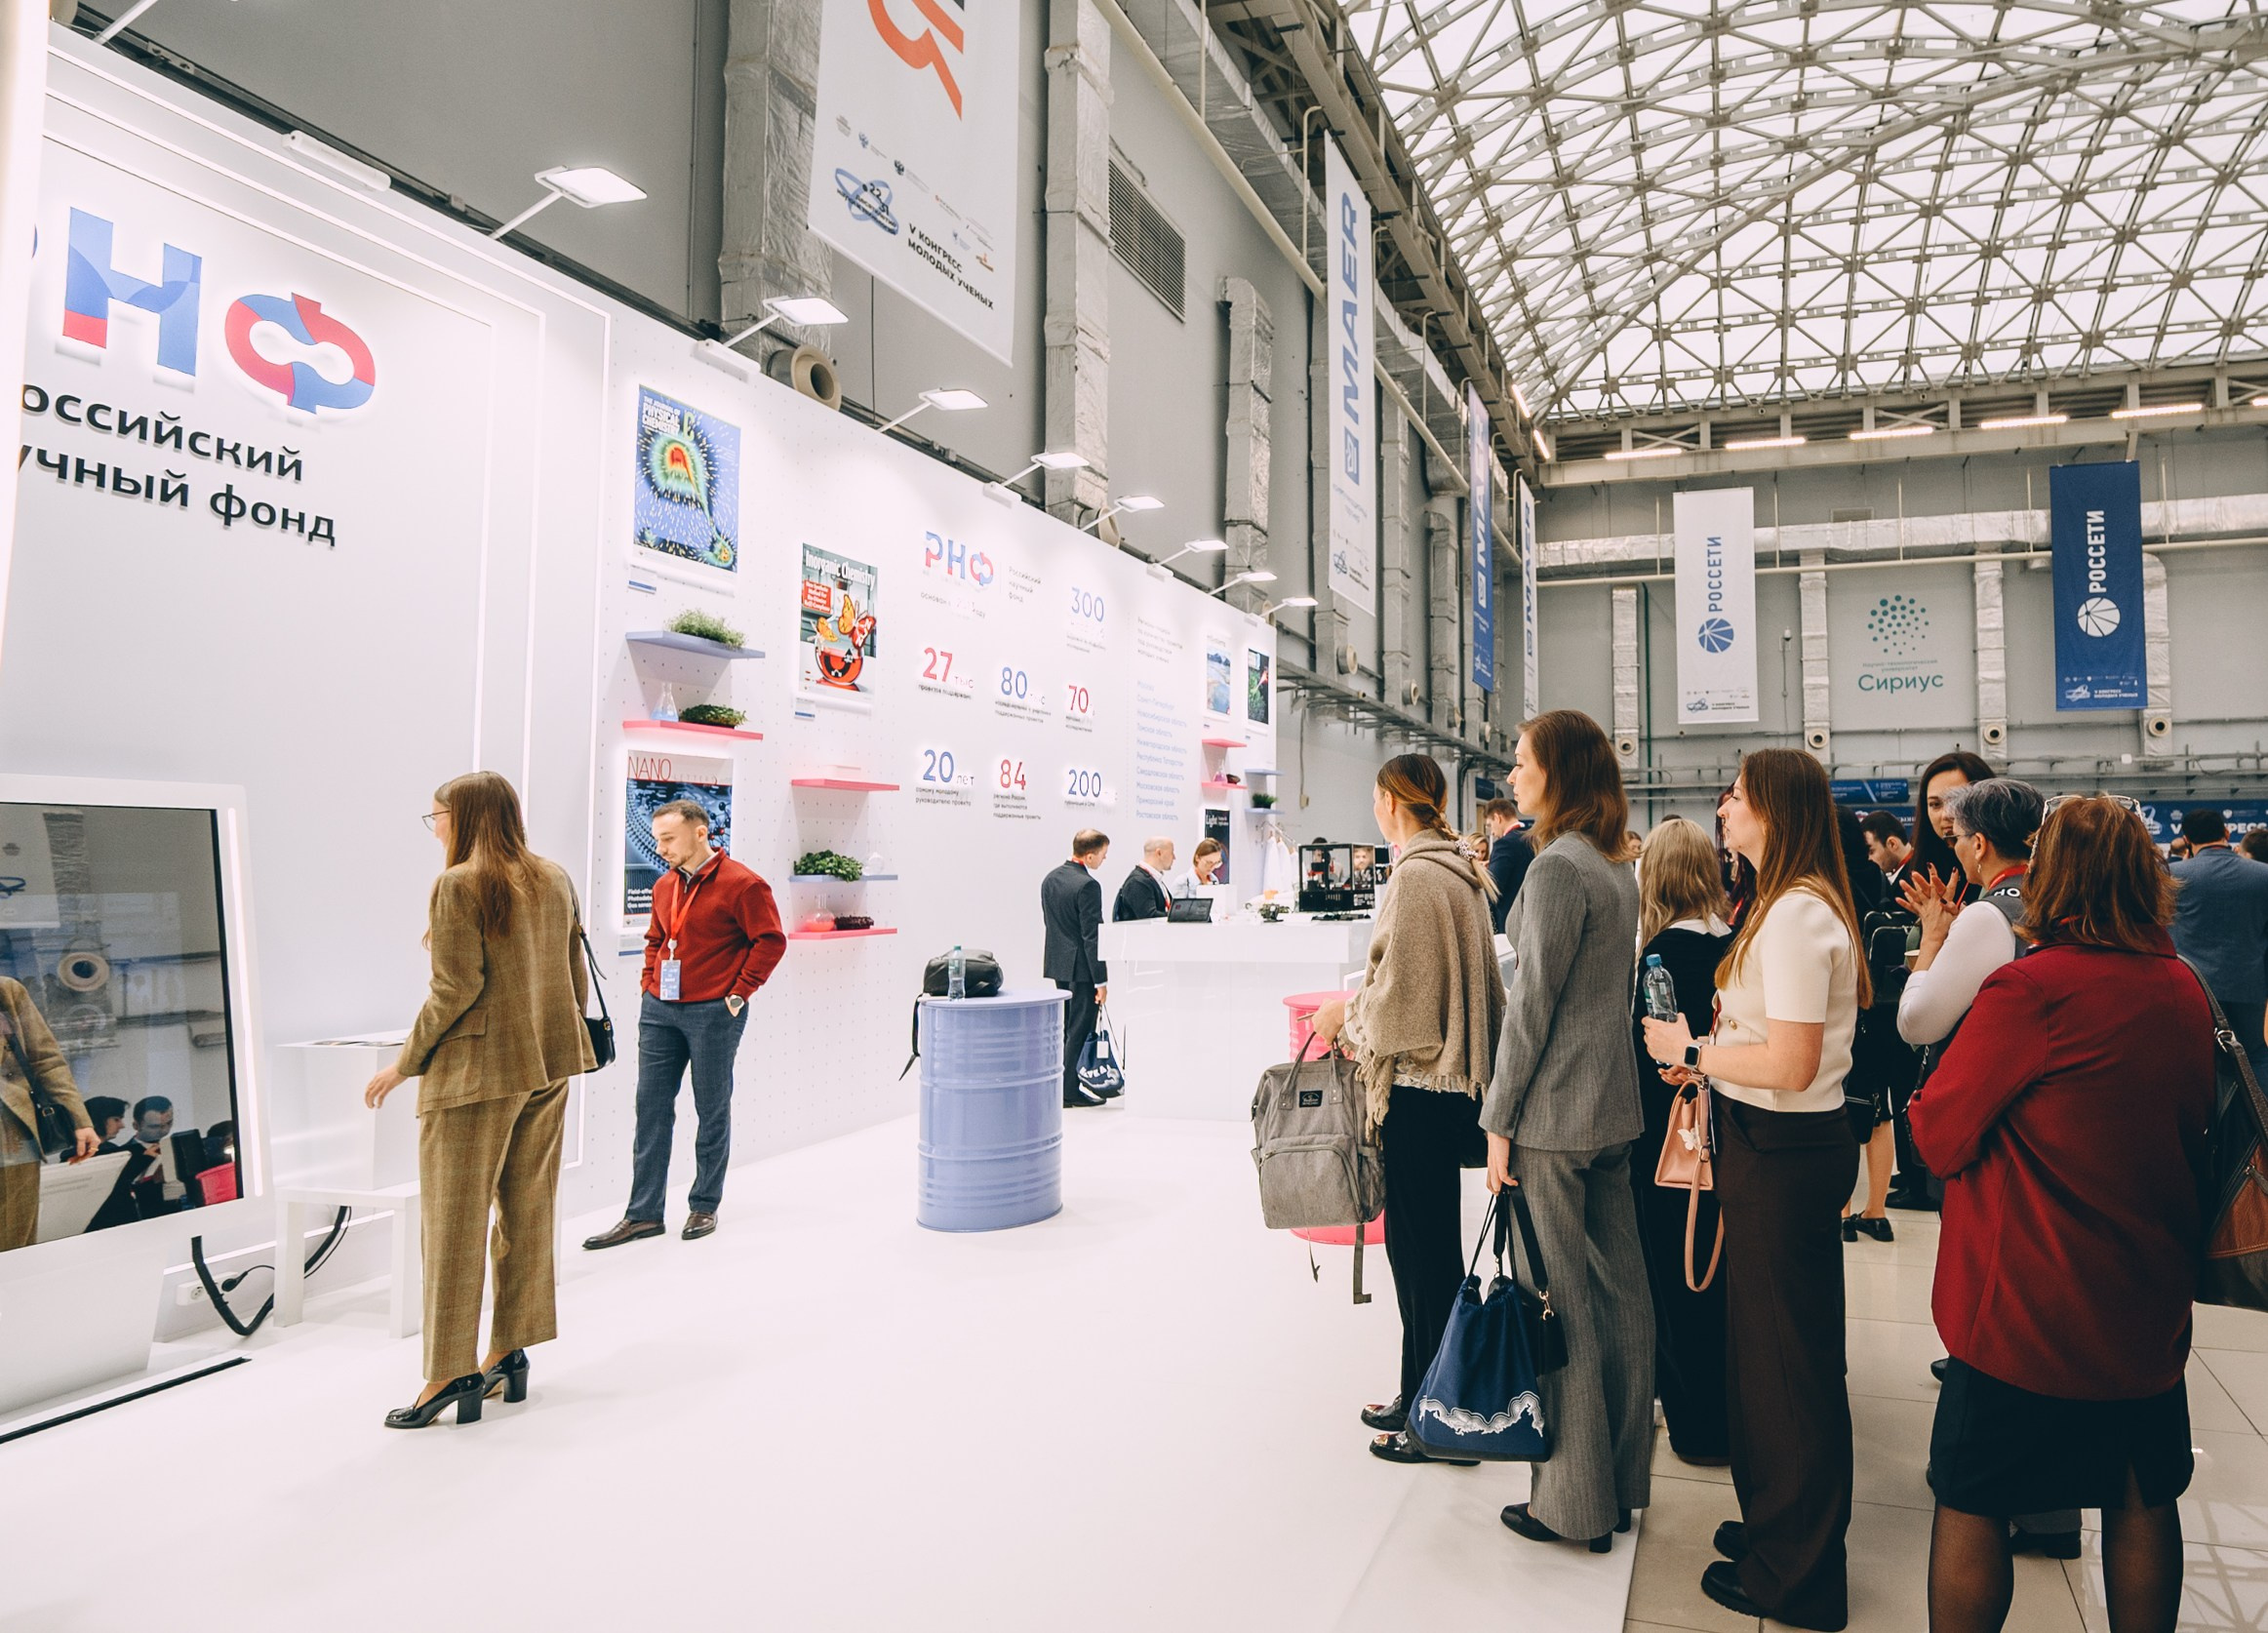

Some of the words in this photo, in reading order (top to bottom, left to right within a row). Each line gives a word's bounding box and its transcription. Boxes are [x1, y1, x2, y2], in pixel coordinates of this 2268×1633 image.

[908, 222, 917, 235] V
[919, 230, 963, 274] КОНГРЕСС
[908, 238, 956, 284] МОЛОДЫХ
[957, 276, 994, 310] УЧЕНЫХ
[32, 206, 376, 415] НФ
[1341, 191, 1360, 425] MAER
[642, 402, 680, 424] PHYSICAL
[642, 414, 681, 437] CHEMISTRY
[209, 483, 337, 547] фонд
[925, 531, 994, 587] РНФ
[2087, 509, 2107, 594] РОССЕТИ
[805, 549, 842, 578] Inorganic
[842, 561, 876, 592] Chemistry
[1706, 536, 1724, 613] РОССЕТИ
[1071, 586, 1104, 622] 300
[922, 647, 953, 683] 27
[1001, 666, 1027, 699] 80
[1068, 685, 1090, 713] 70
[1857, 673, 1944, 695] Сириус
[626, 755, 672, 781] NANO
[922, 748, 955, 783] 20
[1000, 759, 1027, 790] 84
[1068, 769, 1102, 798] 200
[2170, 822, 2182, 834] V
